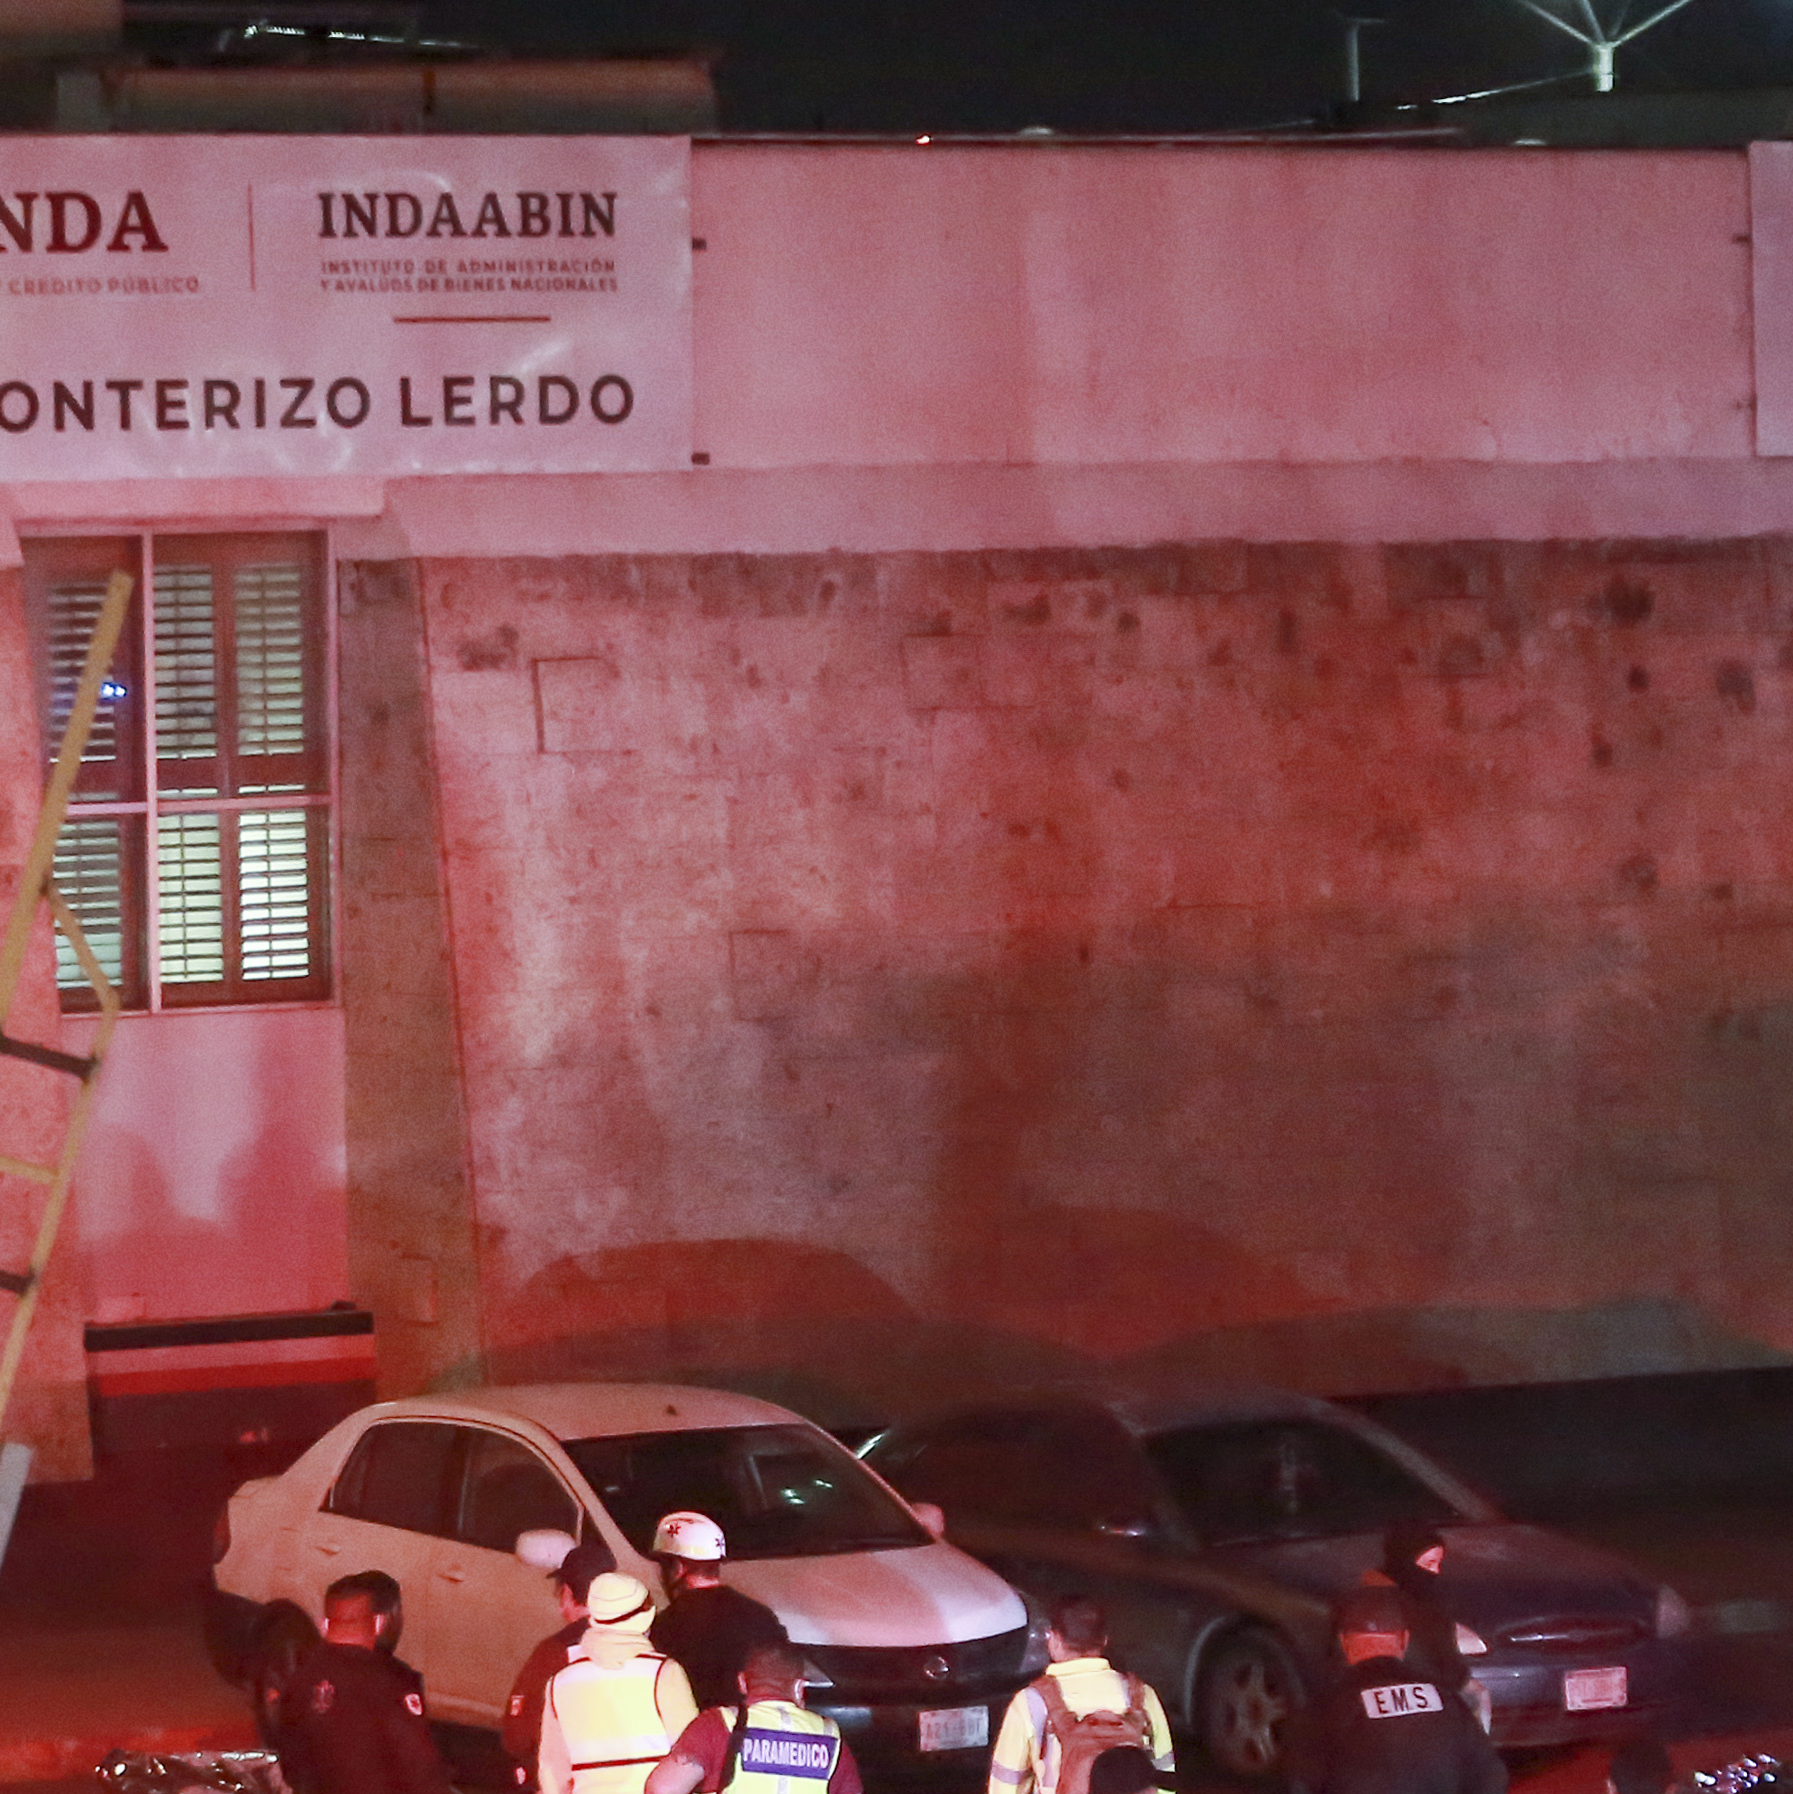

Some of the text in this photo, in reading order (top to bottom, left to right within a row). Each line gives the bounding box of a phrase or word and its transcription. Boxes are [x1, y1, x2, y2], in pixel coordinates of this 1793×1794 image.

[317, 192, 618, 238] INDAABIN
[321, 259, 414, 275] INSTITUTO
[424, 259, 447, 274] DE
[321, 278, 329, 292] Y
[417, 278, 439, 293] DE
[511, 278, 618, 293] NACIONALES
[398, 373, 635, 427] LERDO
[1374, 1687, 1428, 1714] EMS
[743, 1737, 830, 1769] PARAMEDICO
